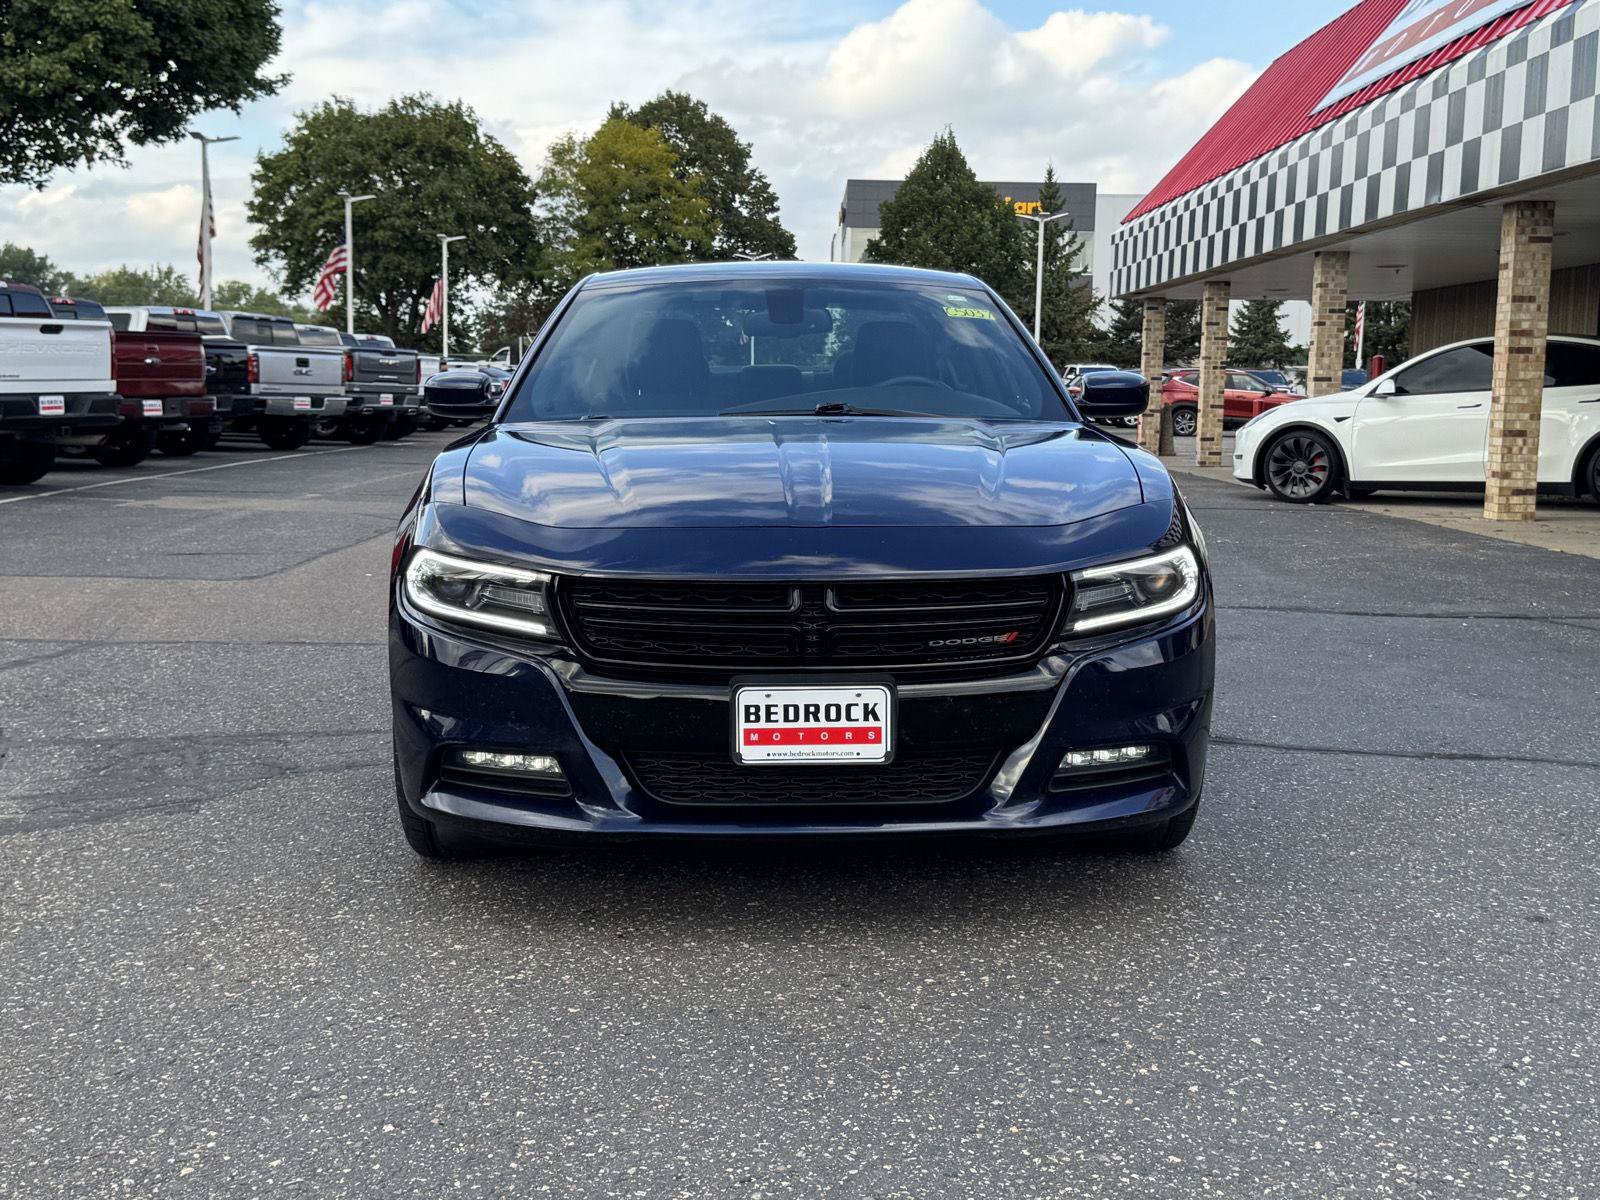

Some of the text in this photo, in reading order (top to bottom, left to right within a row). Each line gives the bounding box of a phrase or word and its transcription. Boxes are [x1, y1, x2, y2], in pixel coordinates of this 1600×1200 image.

[929, 634, 1008, 646] DODGE
[744, 703, 881, 723] BEDROCK
[750, 732, 875, 741] MOTORS
